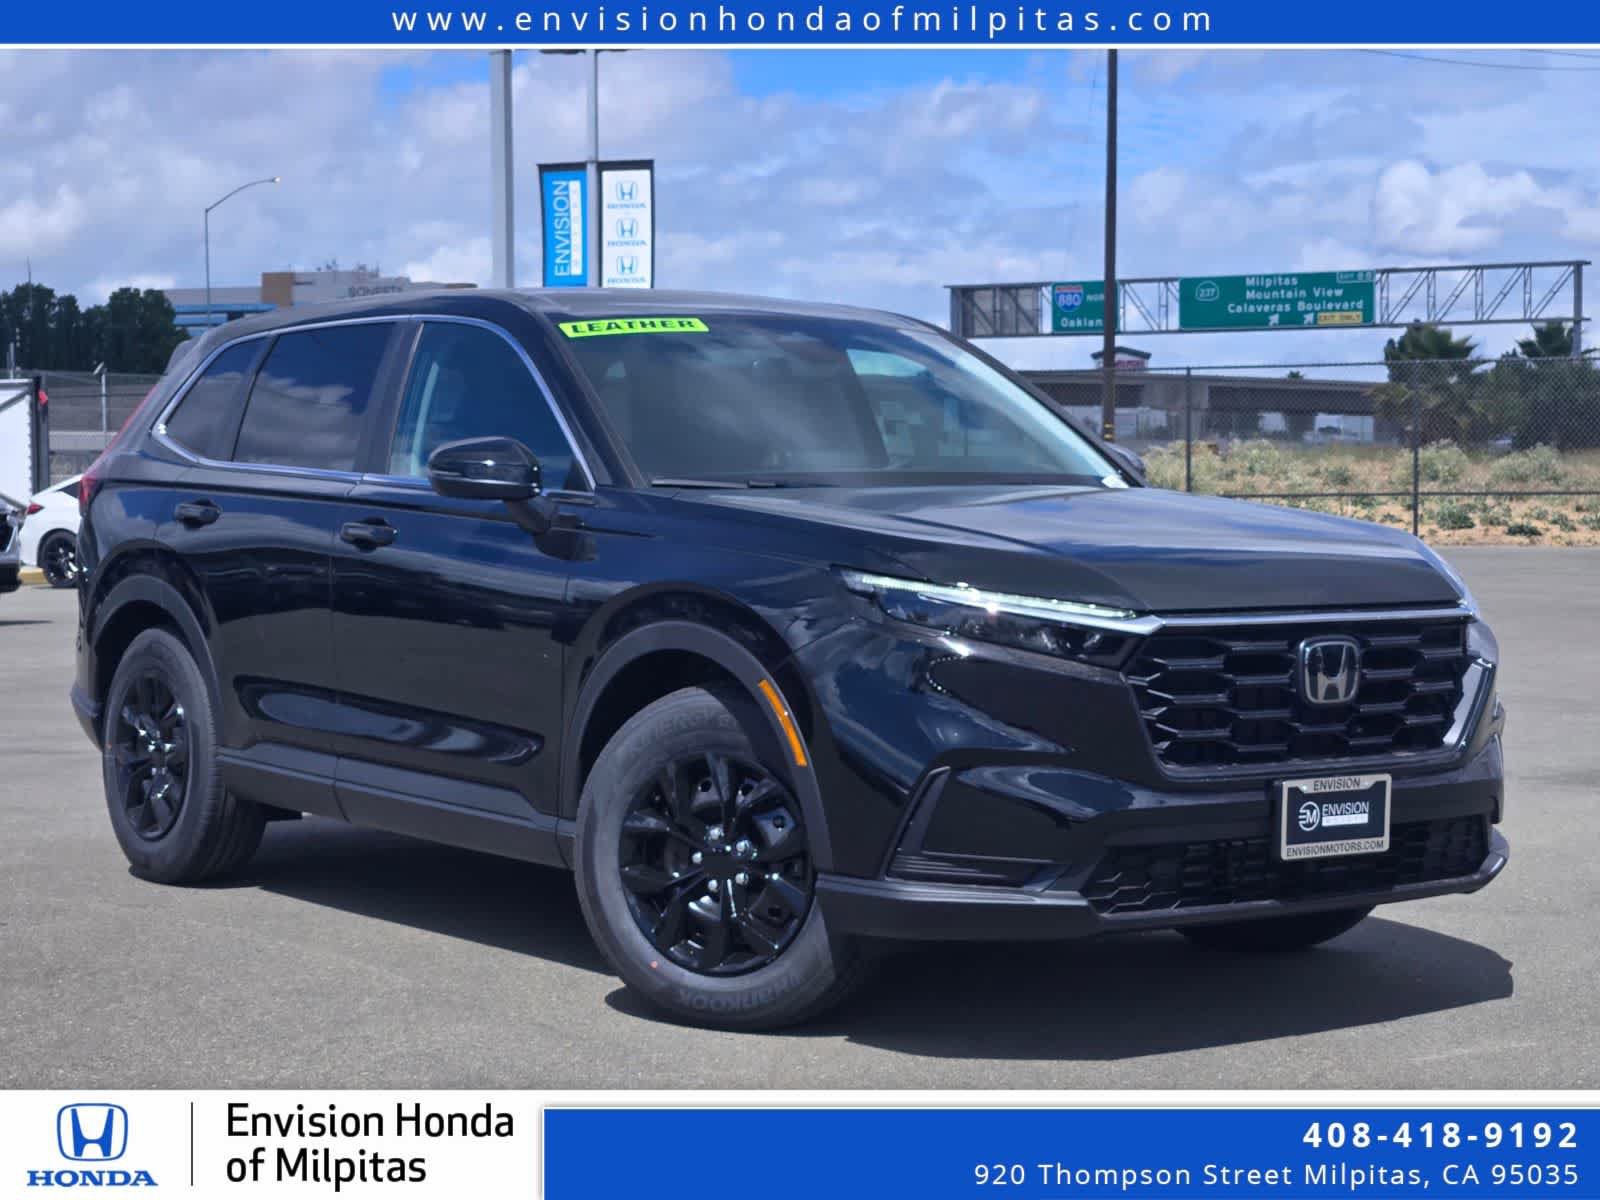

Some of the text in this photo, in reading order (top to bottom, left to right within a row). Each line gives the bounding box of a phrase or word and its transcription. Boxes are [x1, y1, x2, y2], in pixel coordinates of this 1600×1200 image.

[552, 180, 569, 276] ENVISION
[1245, 275, 1299, 288] Milpitas
[1058, 293, 1081, 307] 880
[1245, 286, 1344, 300] Mountain View
[1227, 299, 1364, 314] Calaveras Boulevard
[570, 319, 696, 334] LEATHER
[1060, 317, 1104, 328] Oaklan
[1313, 779, 1360, 792] ENVISION
[1322, 801, 1370, 816] ENVISION
[1287, 839, 1384, 857] ENVISIONMOTORS.COM
